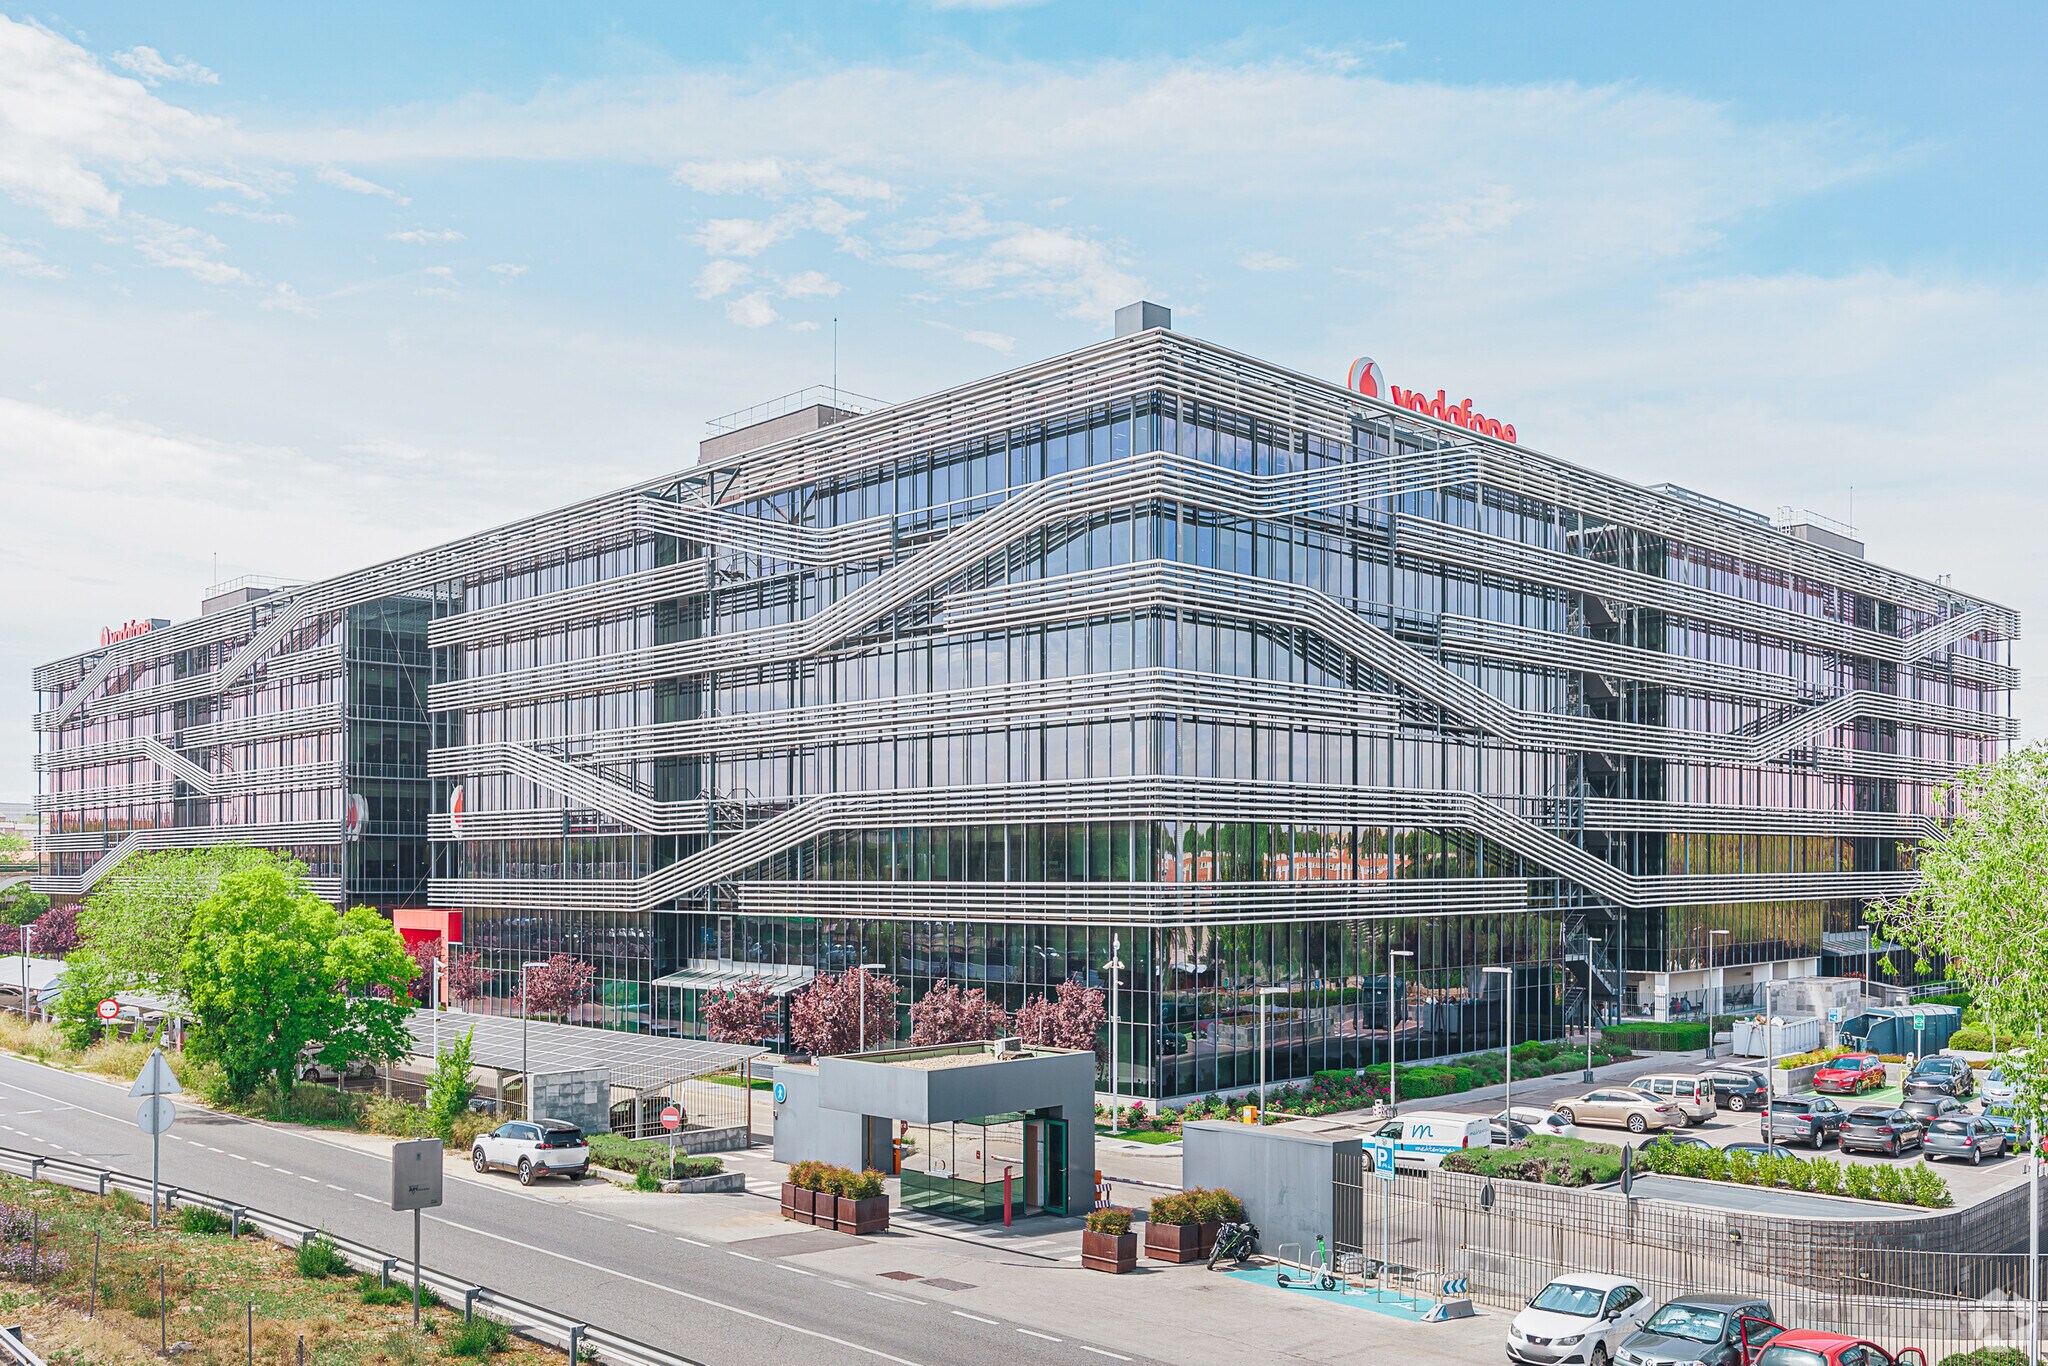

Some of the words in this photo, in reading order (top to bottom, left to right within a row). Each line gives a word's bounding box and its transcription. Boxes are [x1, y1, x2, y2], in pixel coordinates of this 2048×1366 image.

[1391, 385, 1517, 444] vodafone
[111, 619, 151, 644] vodafone
[1377, 1148, 1389, 1167] P
